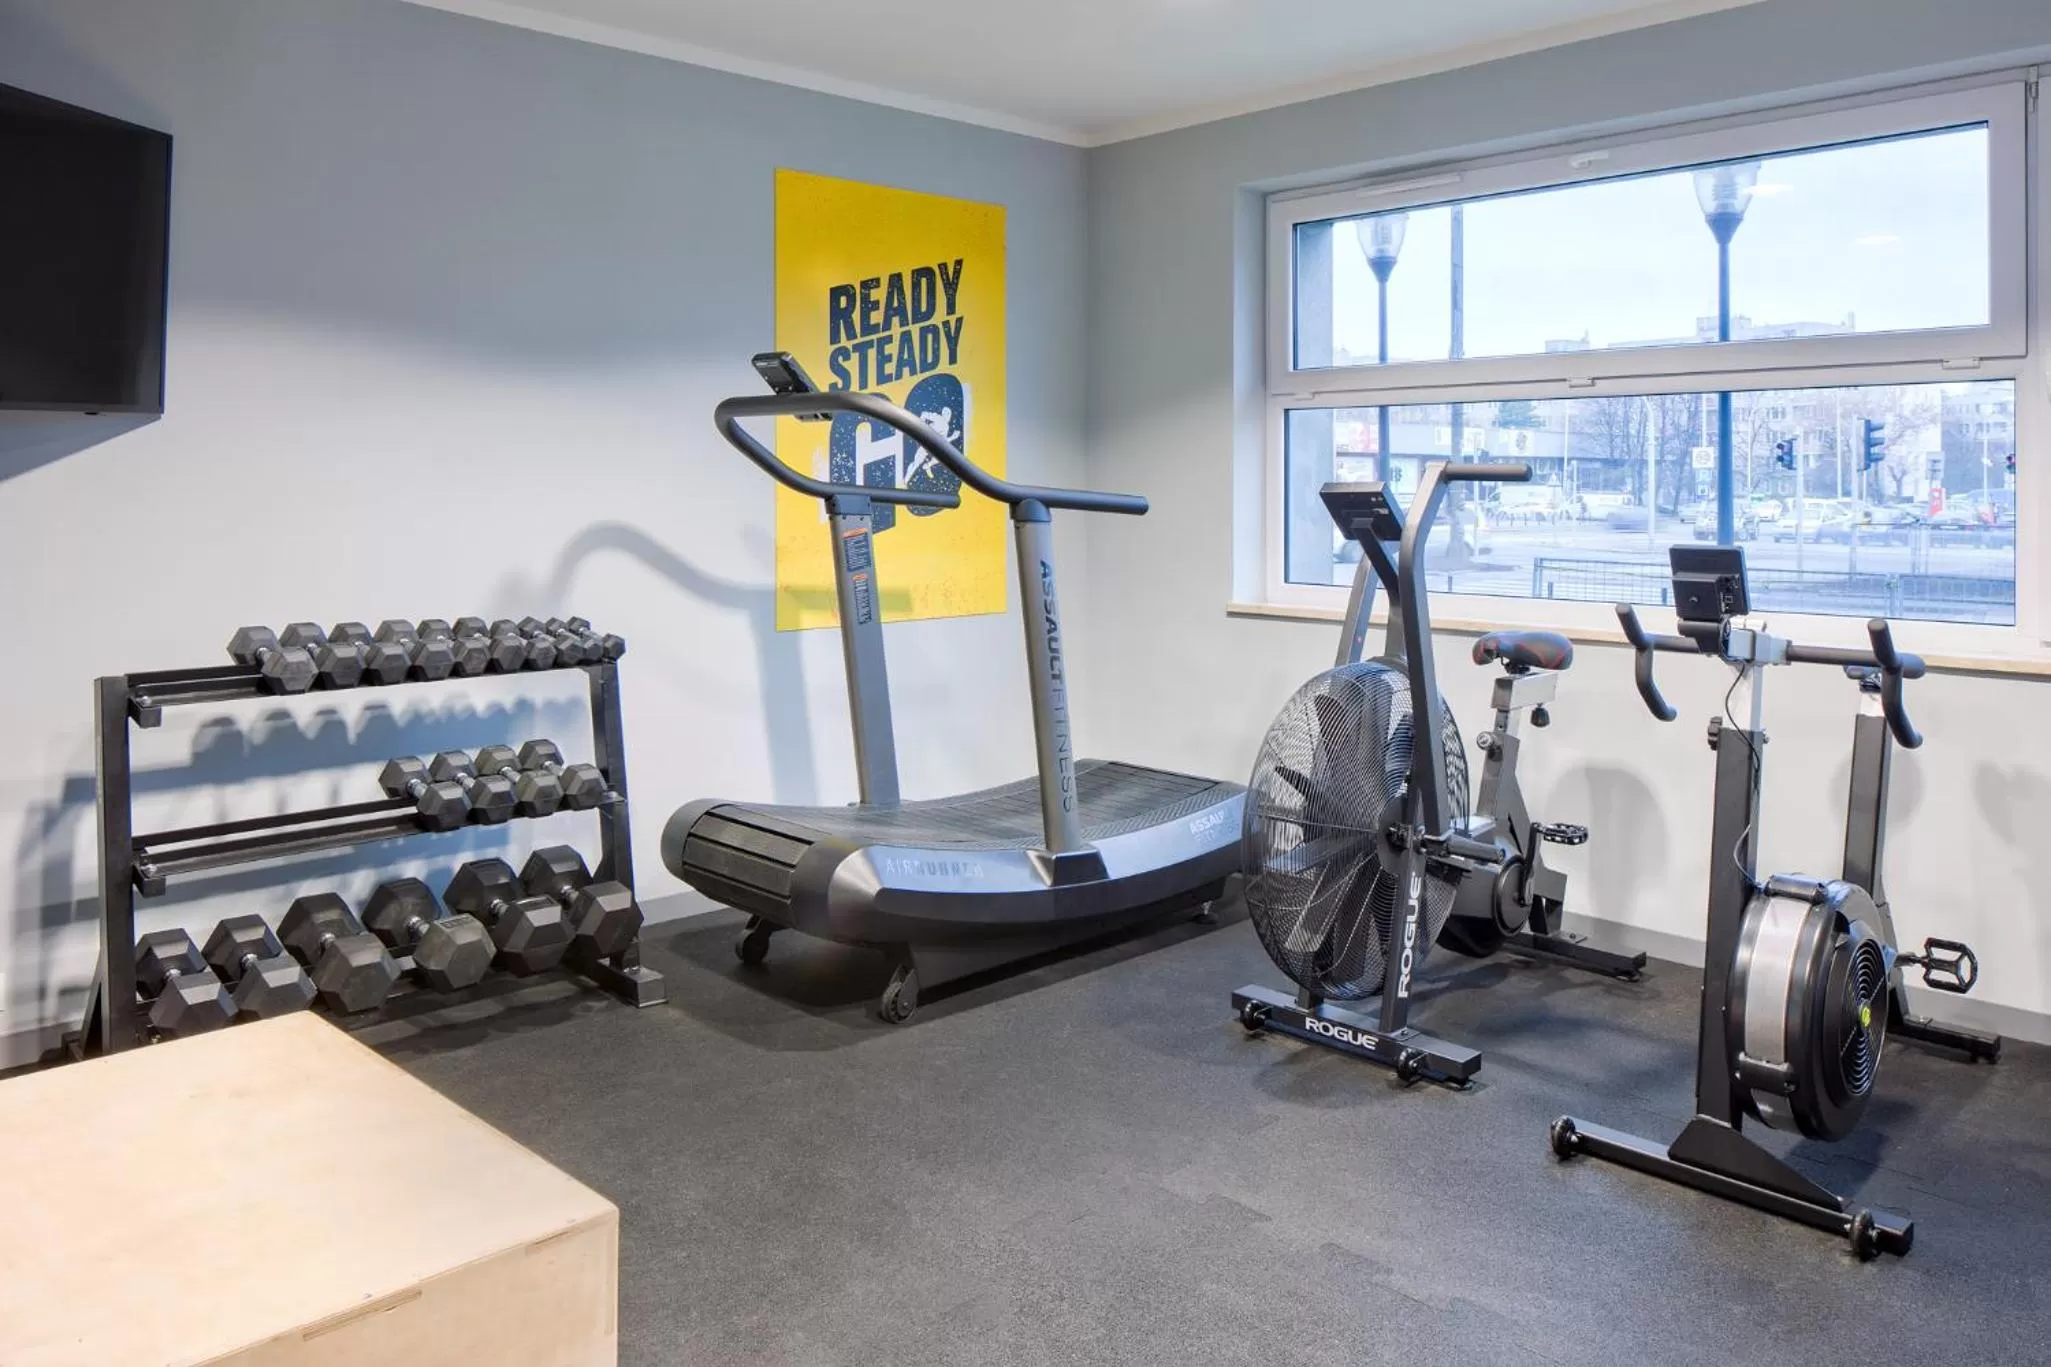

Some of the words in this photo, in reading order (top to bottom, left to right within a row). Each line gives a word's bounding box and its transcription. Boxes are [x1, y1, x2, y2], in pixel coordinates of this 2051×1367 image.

[829, 258, 964, 345] READY
[828, 316, 964, 393] STEADY
[1397, 875, 1422, 998] ROGUE
[1304, 1016, 1379, 1051] ROGUE
